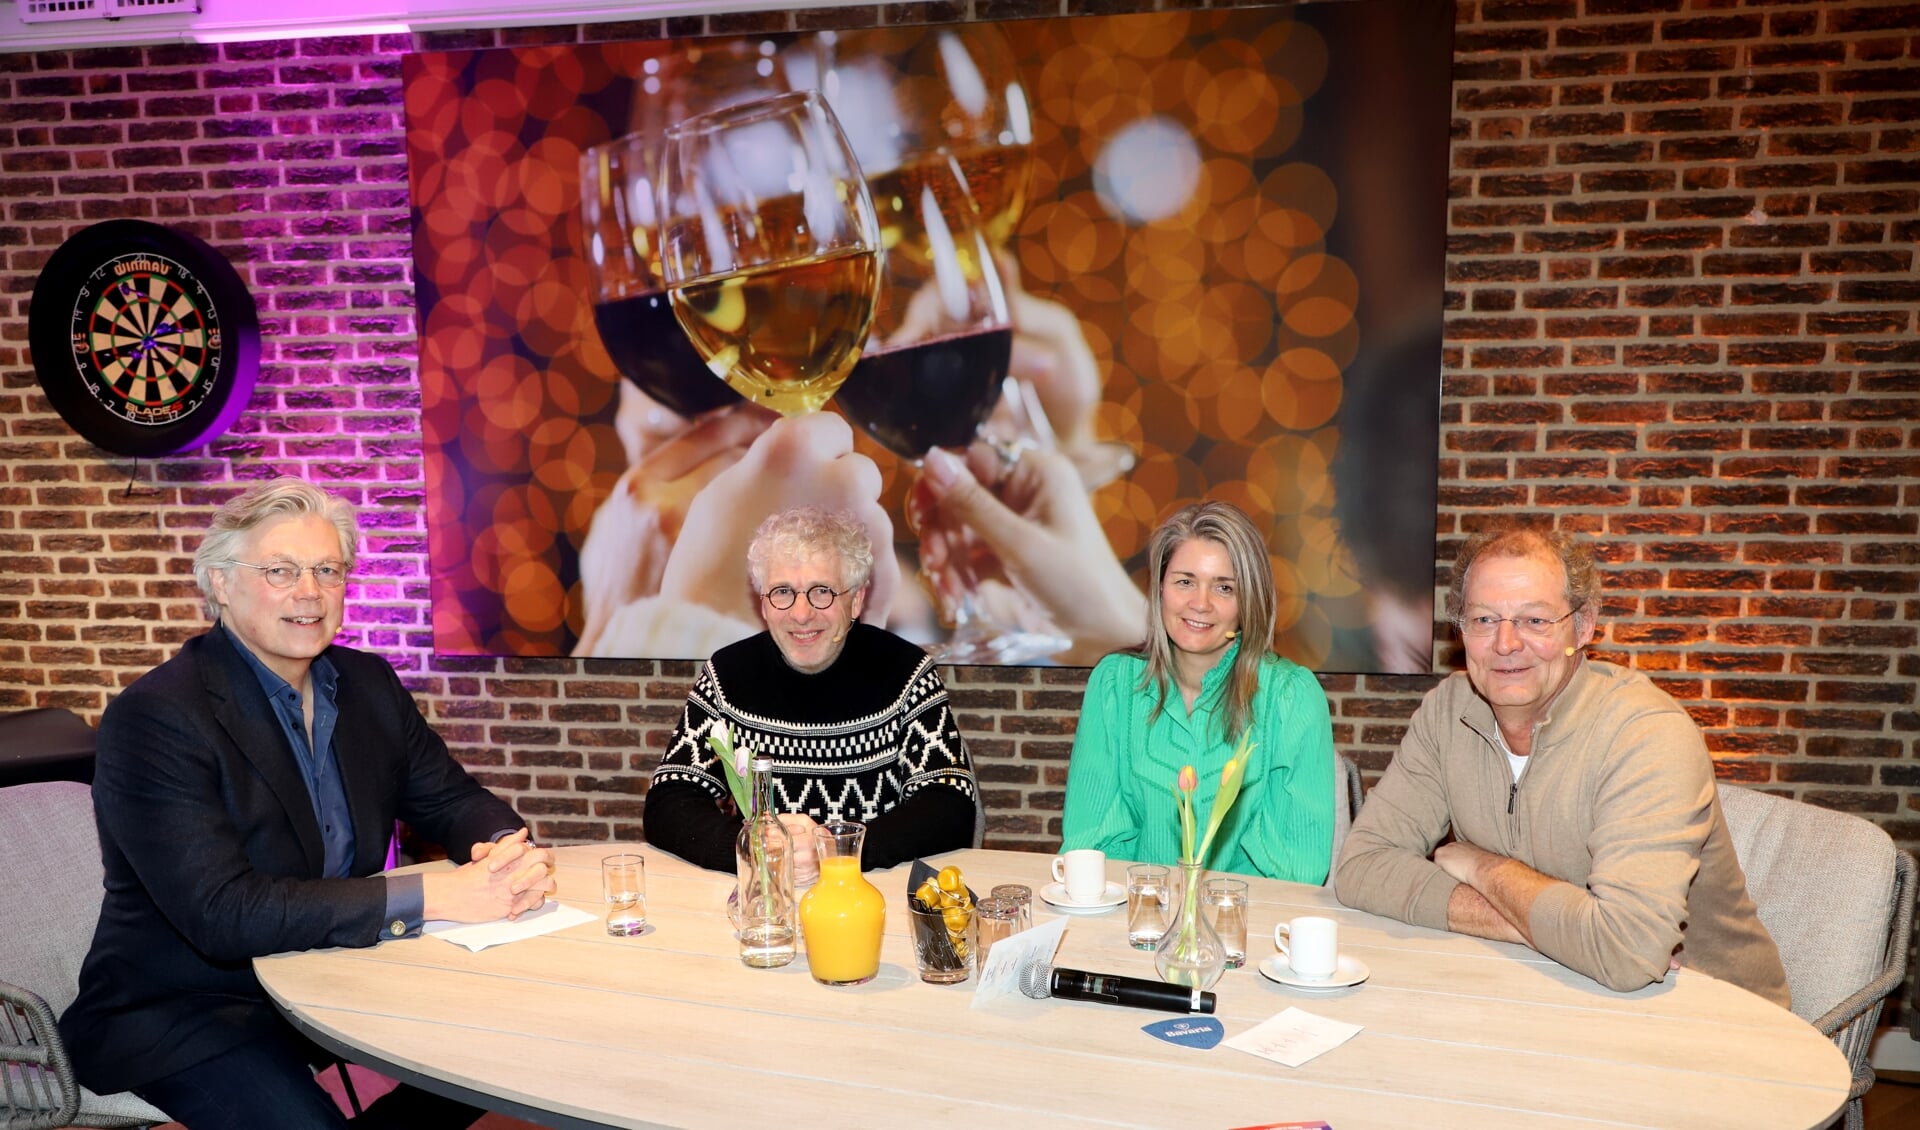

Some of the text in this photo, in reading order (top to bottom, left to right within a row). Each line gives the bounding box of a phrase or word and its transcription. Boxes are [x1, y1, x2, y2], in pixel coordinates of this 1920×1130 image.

[114, 259, 170, 276] WINMAU
[177, 265, 186, 279] 18
[188, 399, 197, 410] 2
[1165, 1026, 1213, 1038] Bavaria
